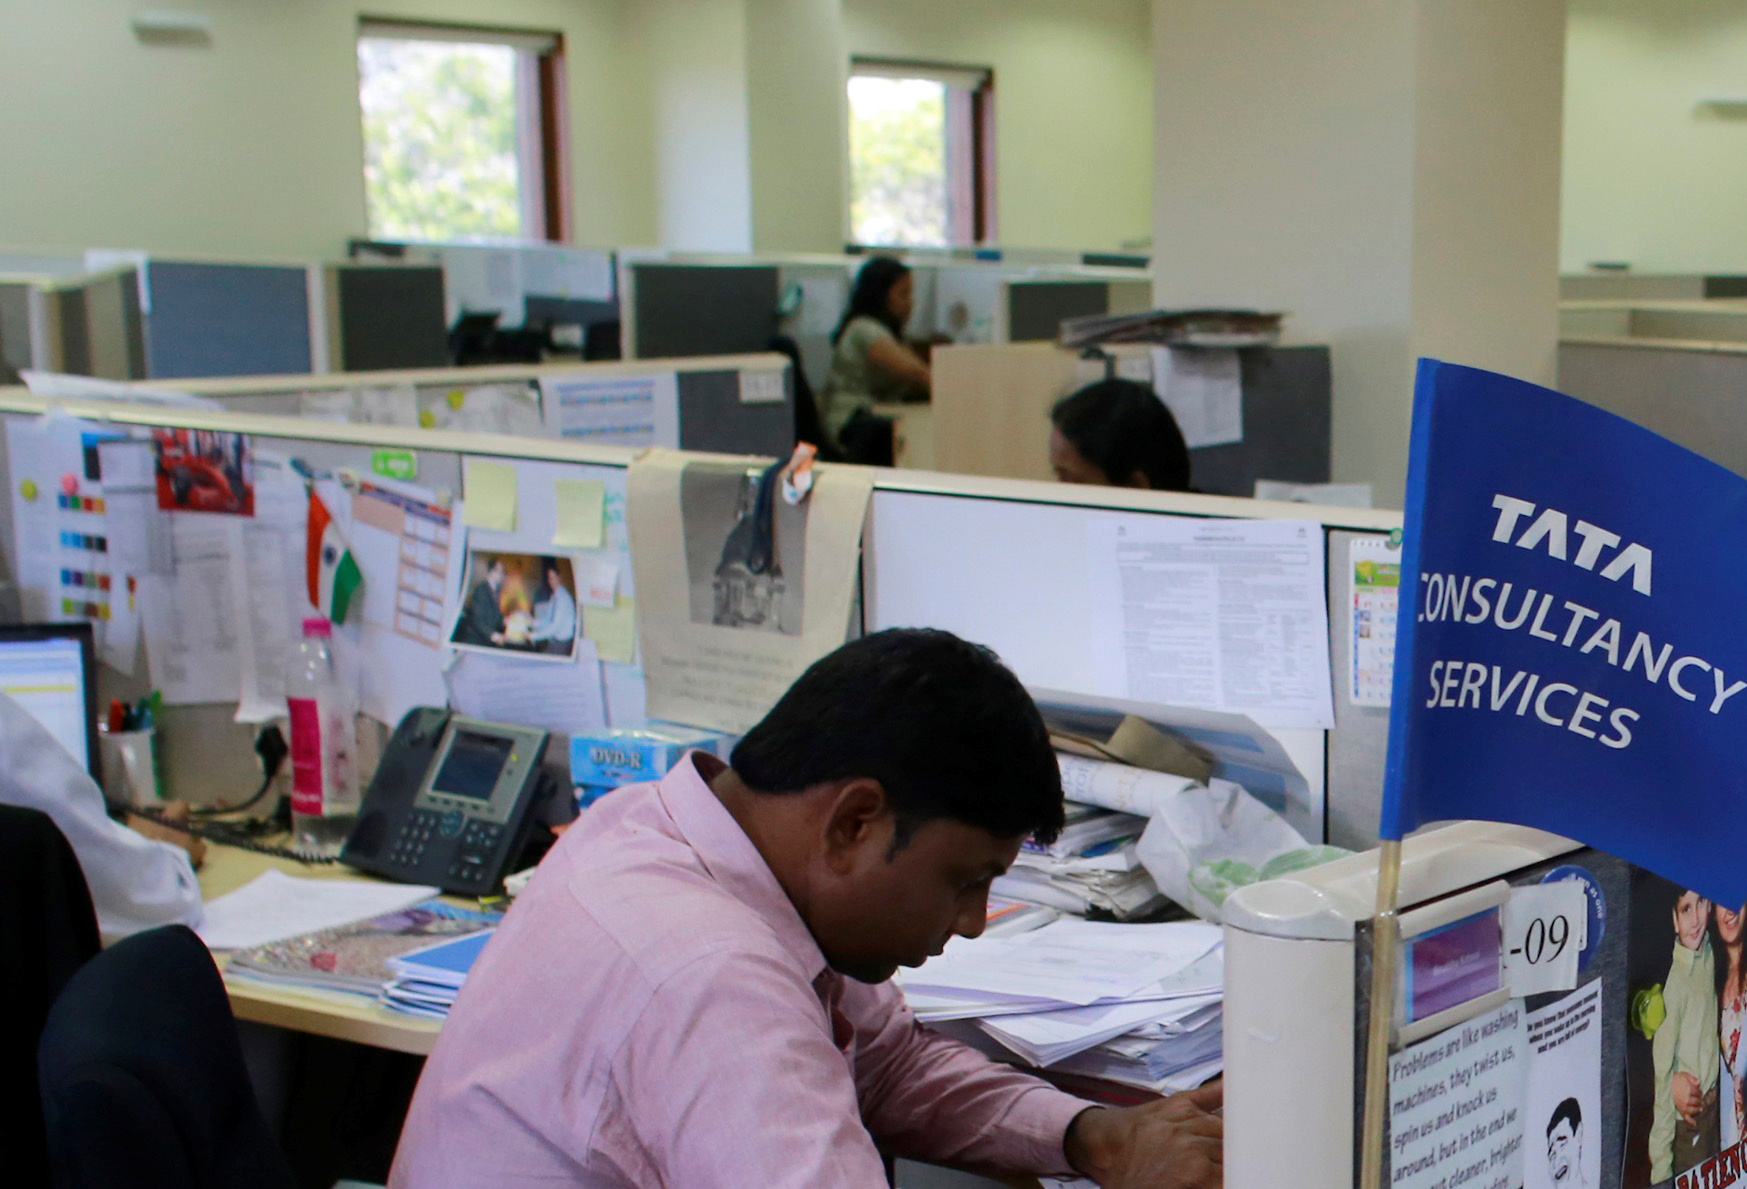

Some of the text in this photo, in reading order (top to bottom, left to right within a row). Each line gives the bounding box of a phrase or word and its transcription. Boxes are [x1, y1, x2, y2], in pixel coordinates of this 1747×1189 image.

[1491, 493, 1654, 597] TATA
[1426, 660, 1640, 751] SERVICES
[1510, 914, 1570, 965] -09
[1393, 1009, 1518, 1083] Problems are like washing
[1393, 1081, 1448, 1115] machines,
[1450, 1067, 1472, 1089] they
[1474, 1050, 1499, 1077] twist
[1394, 1087, 1497, 1155] spin us and knock us
[1394, 1107, 1518, 1183] around, but in the end we
[1449, 1158, 1488, 1189] cleaner,
[1489, 1133, 1523, 1168] brighter
